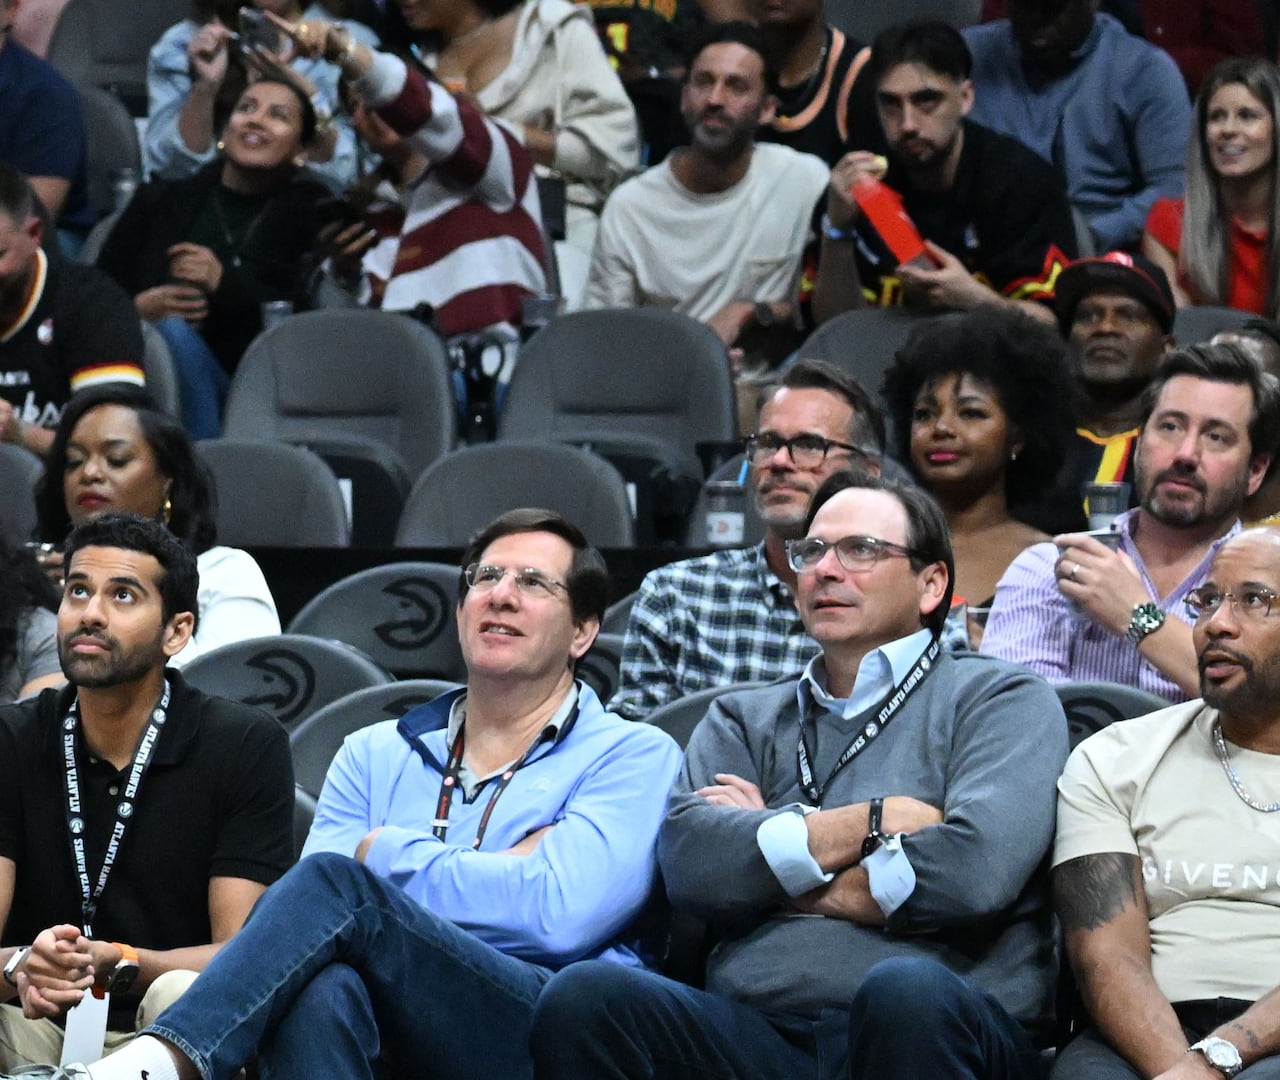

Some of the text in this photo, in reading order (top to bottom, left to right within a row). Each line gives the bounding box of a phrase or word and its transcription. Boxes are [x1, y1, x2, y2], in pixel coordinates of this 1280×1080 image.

[878, 689, 906, 724] ATLANTA
[64, 733, 82, 813] ATLANTA HAWKS
[124, 724, 158, 798] ATLANTA HAWKS
[73, 837, 87, 872] HAWKS
[105, 821, 126, 864] ATLANTA
[1142, 856, 1280, 890] GIVEN
